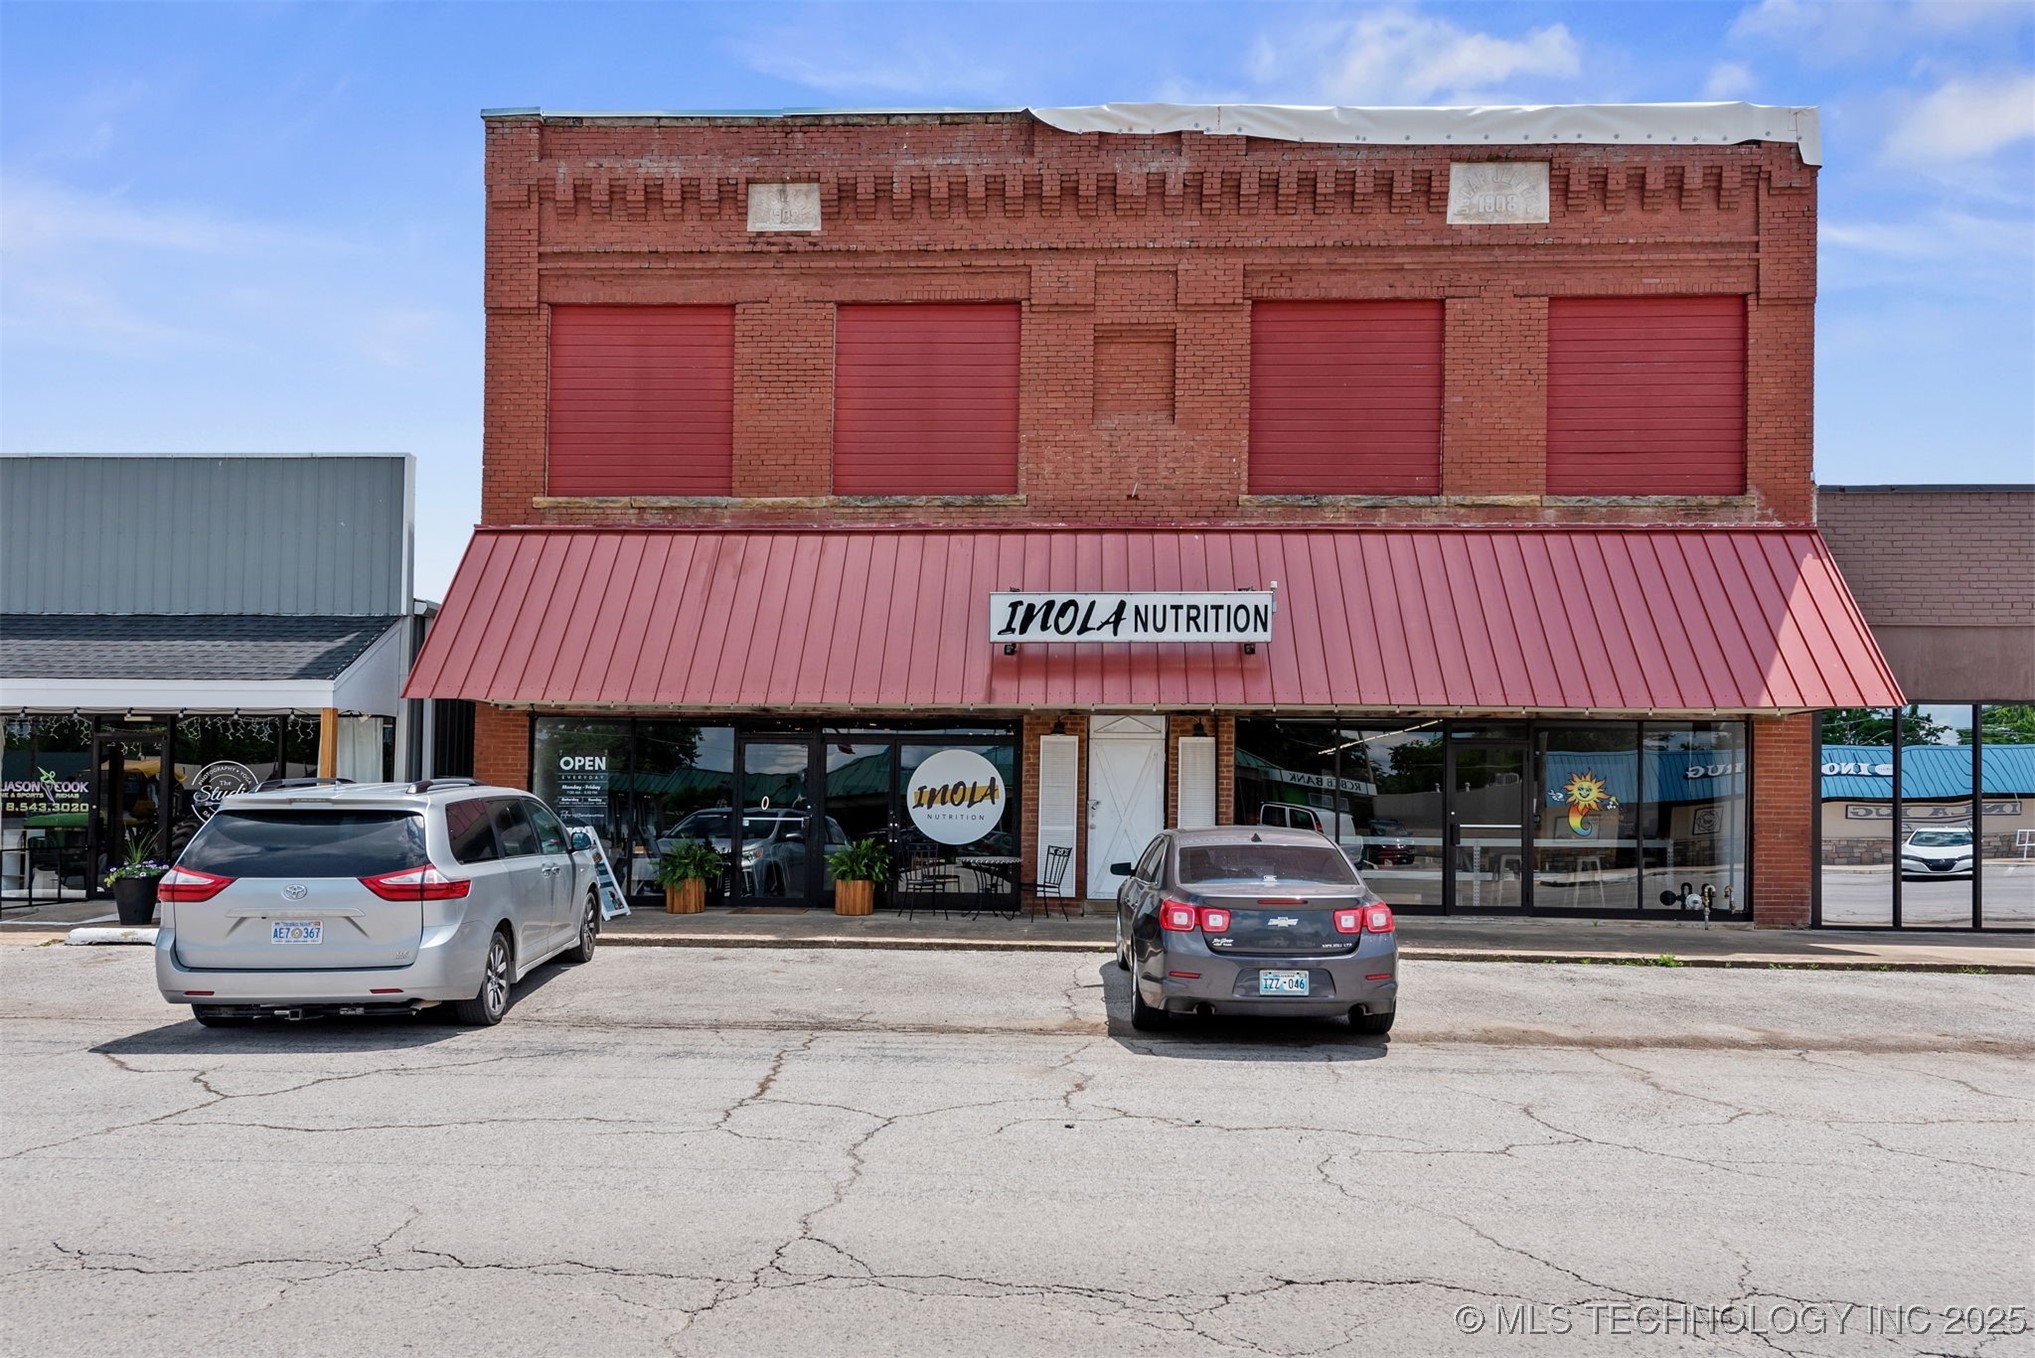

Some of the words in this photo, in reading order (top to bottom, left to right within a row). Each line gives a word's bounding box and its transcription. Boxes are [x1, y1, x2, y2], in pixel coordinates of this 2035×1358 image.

[1478, 193, 1516, 213] 1908
[997, 599, 1127, 637] INOLA
[1134, 604, 1268, 633] NUTRITION
[560, 756, 606, 770] OPEN
[2, 781, 40, 793] JASON
[54, 781, 90, 793] COOK
[193, 783, 247, 801] Studi
[912, 776, 999, 810] INOLA
[272, 927, 291, 939] AE7
[303, 927, 321, 939] 367
